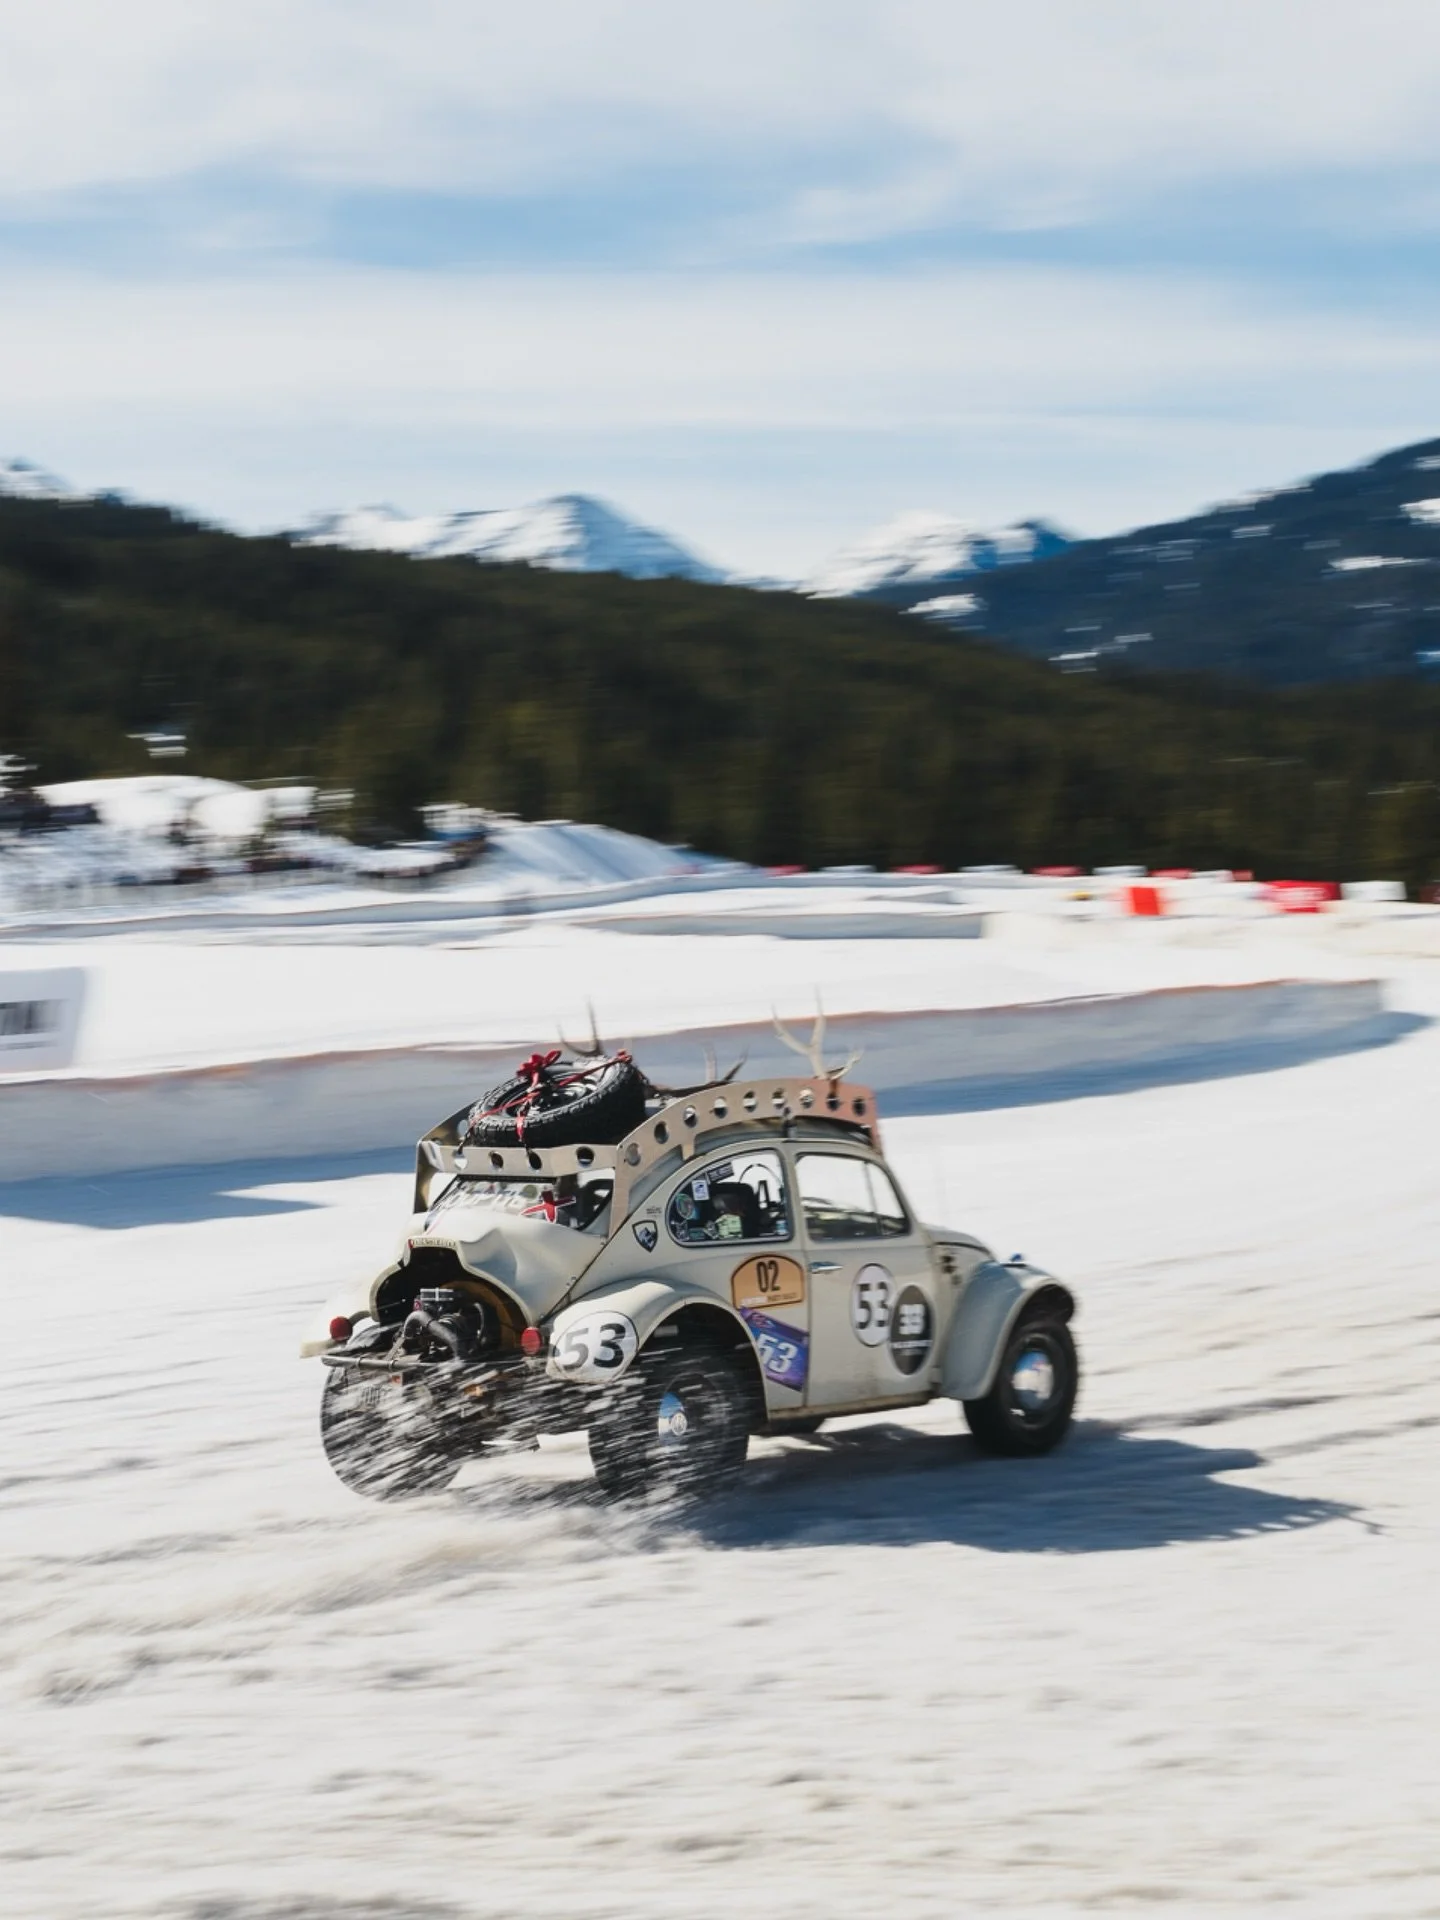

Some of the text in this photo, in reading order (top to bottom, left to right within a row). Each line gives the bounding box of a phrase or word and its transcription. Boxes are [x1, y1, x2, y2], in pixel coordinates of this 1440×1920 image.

[756, 1260, 781, 1293] 02
[857, 1281, 889, 1330] 53
[562, 1322, 626, 1369] 53
[758, 1333, 798, 1373] 53
